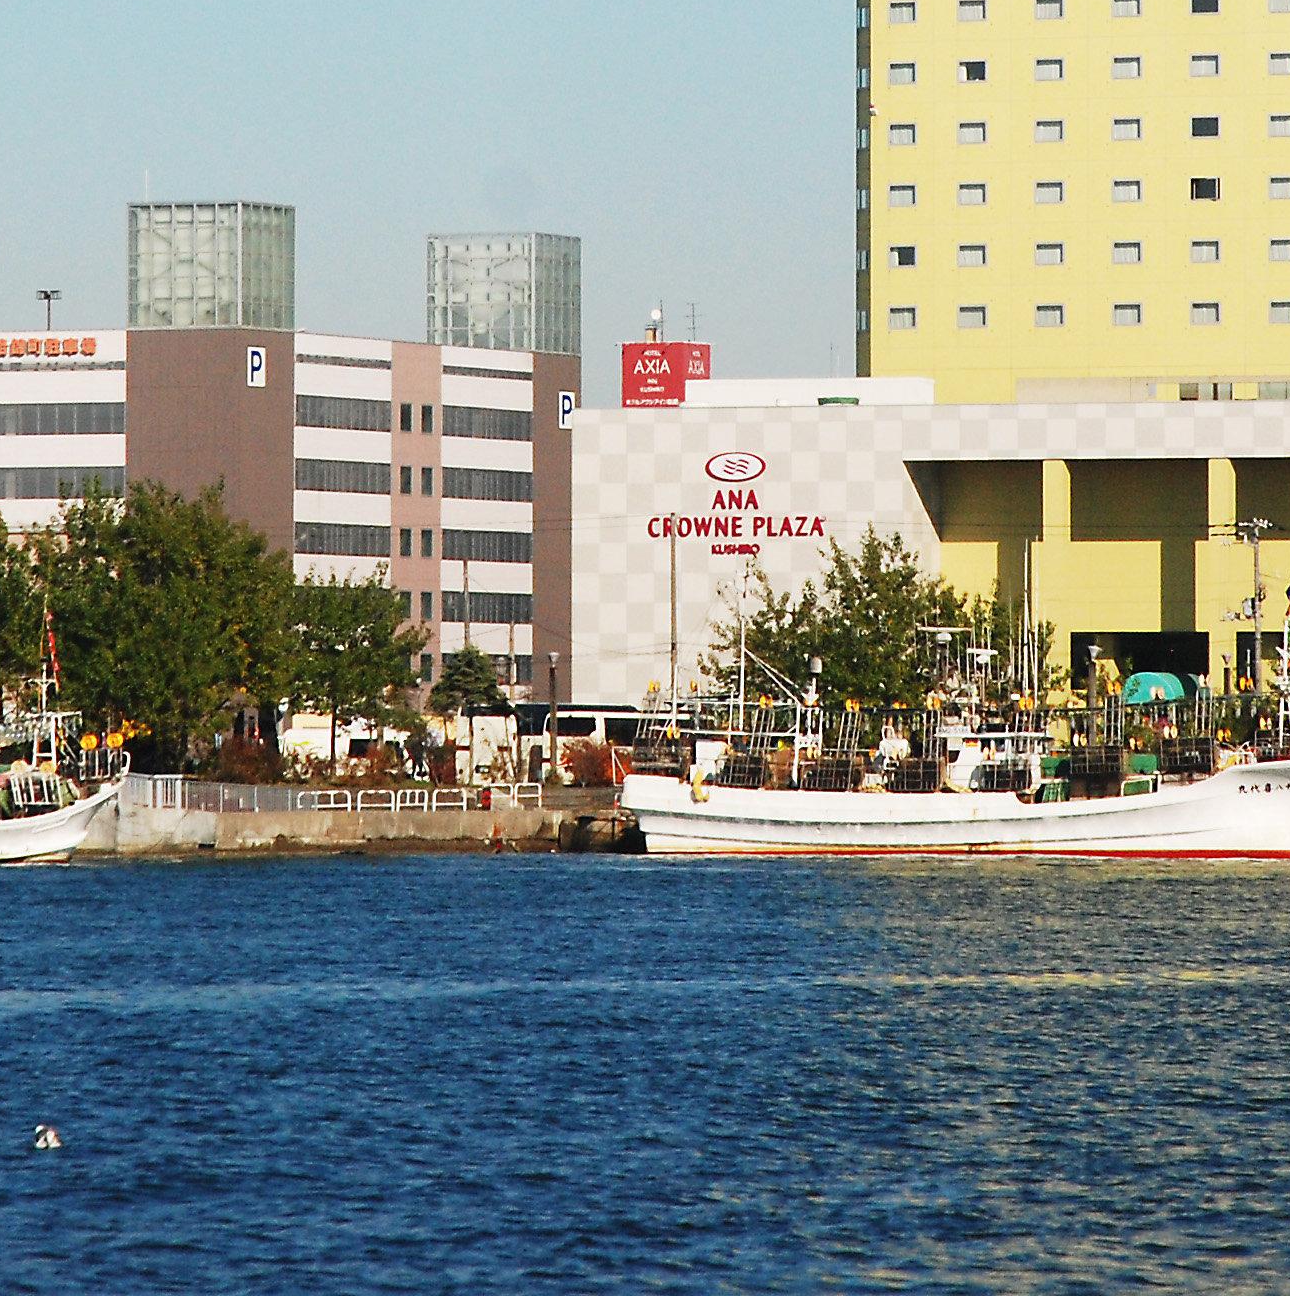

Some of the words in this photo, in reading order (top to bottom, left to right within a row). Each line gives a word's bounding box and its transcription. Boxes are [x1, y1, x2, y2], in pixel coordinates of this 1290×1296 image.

[251, 350, 262, 382] P
[633, 358, 671, 374] AXIA
[562, 395, 573, 424] P
[711, 489, 759, 510] ANA
[647, 516, 743, 538] CROWNE
[753, 516, 825, 538] PLAZA
[711, 544, 760, 555] KUSHIRO
